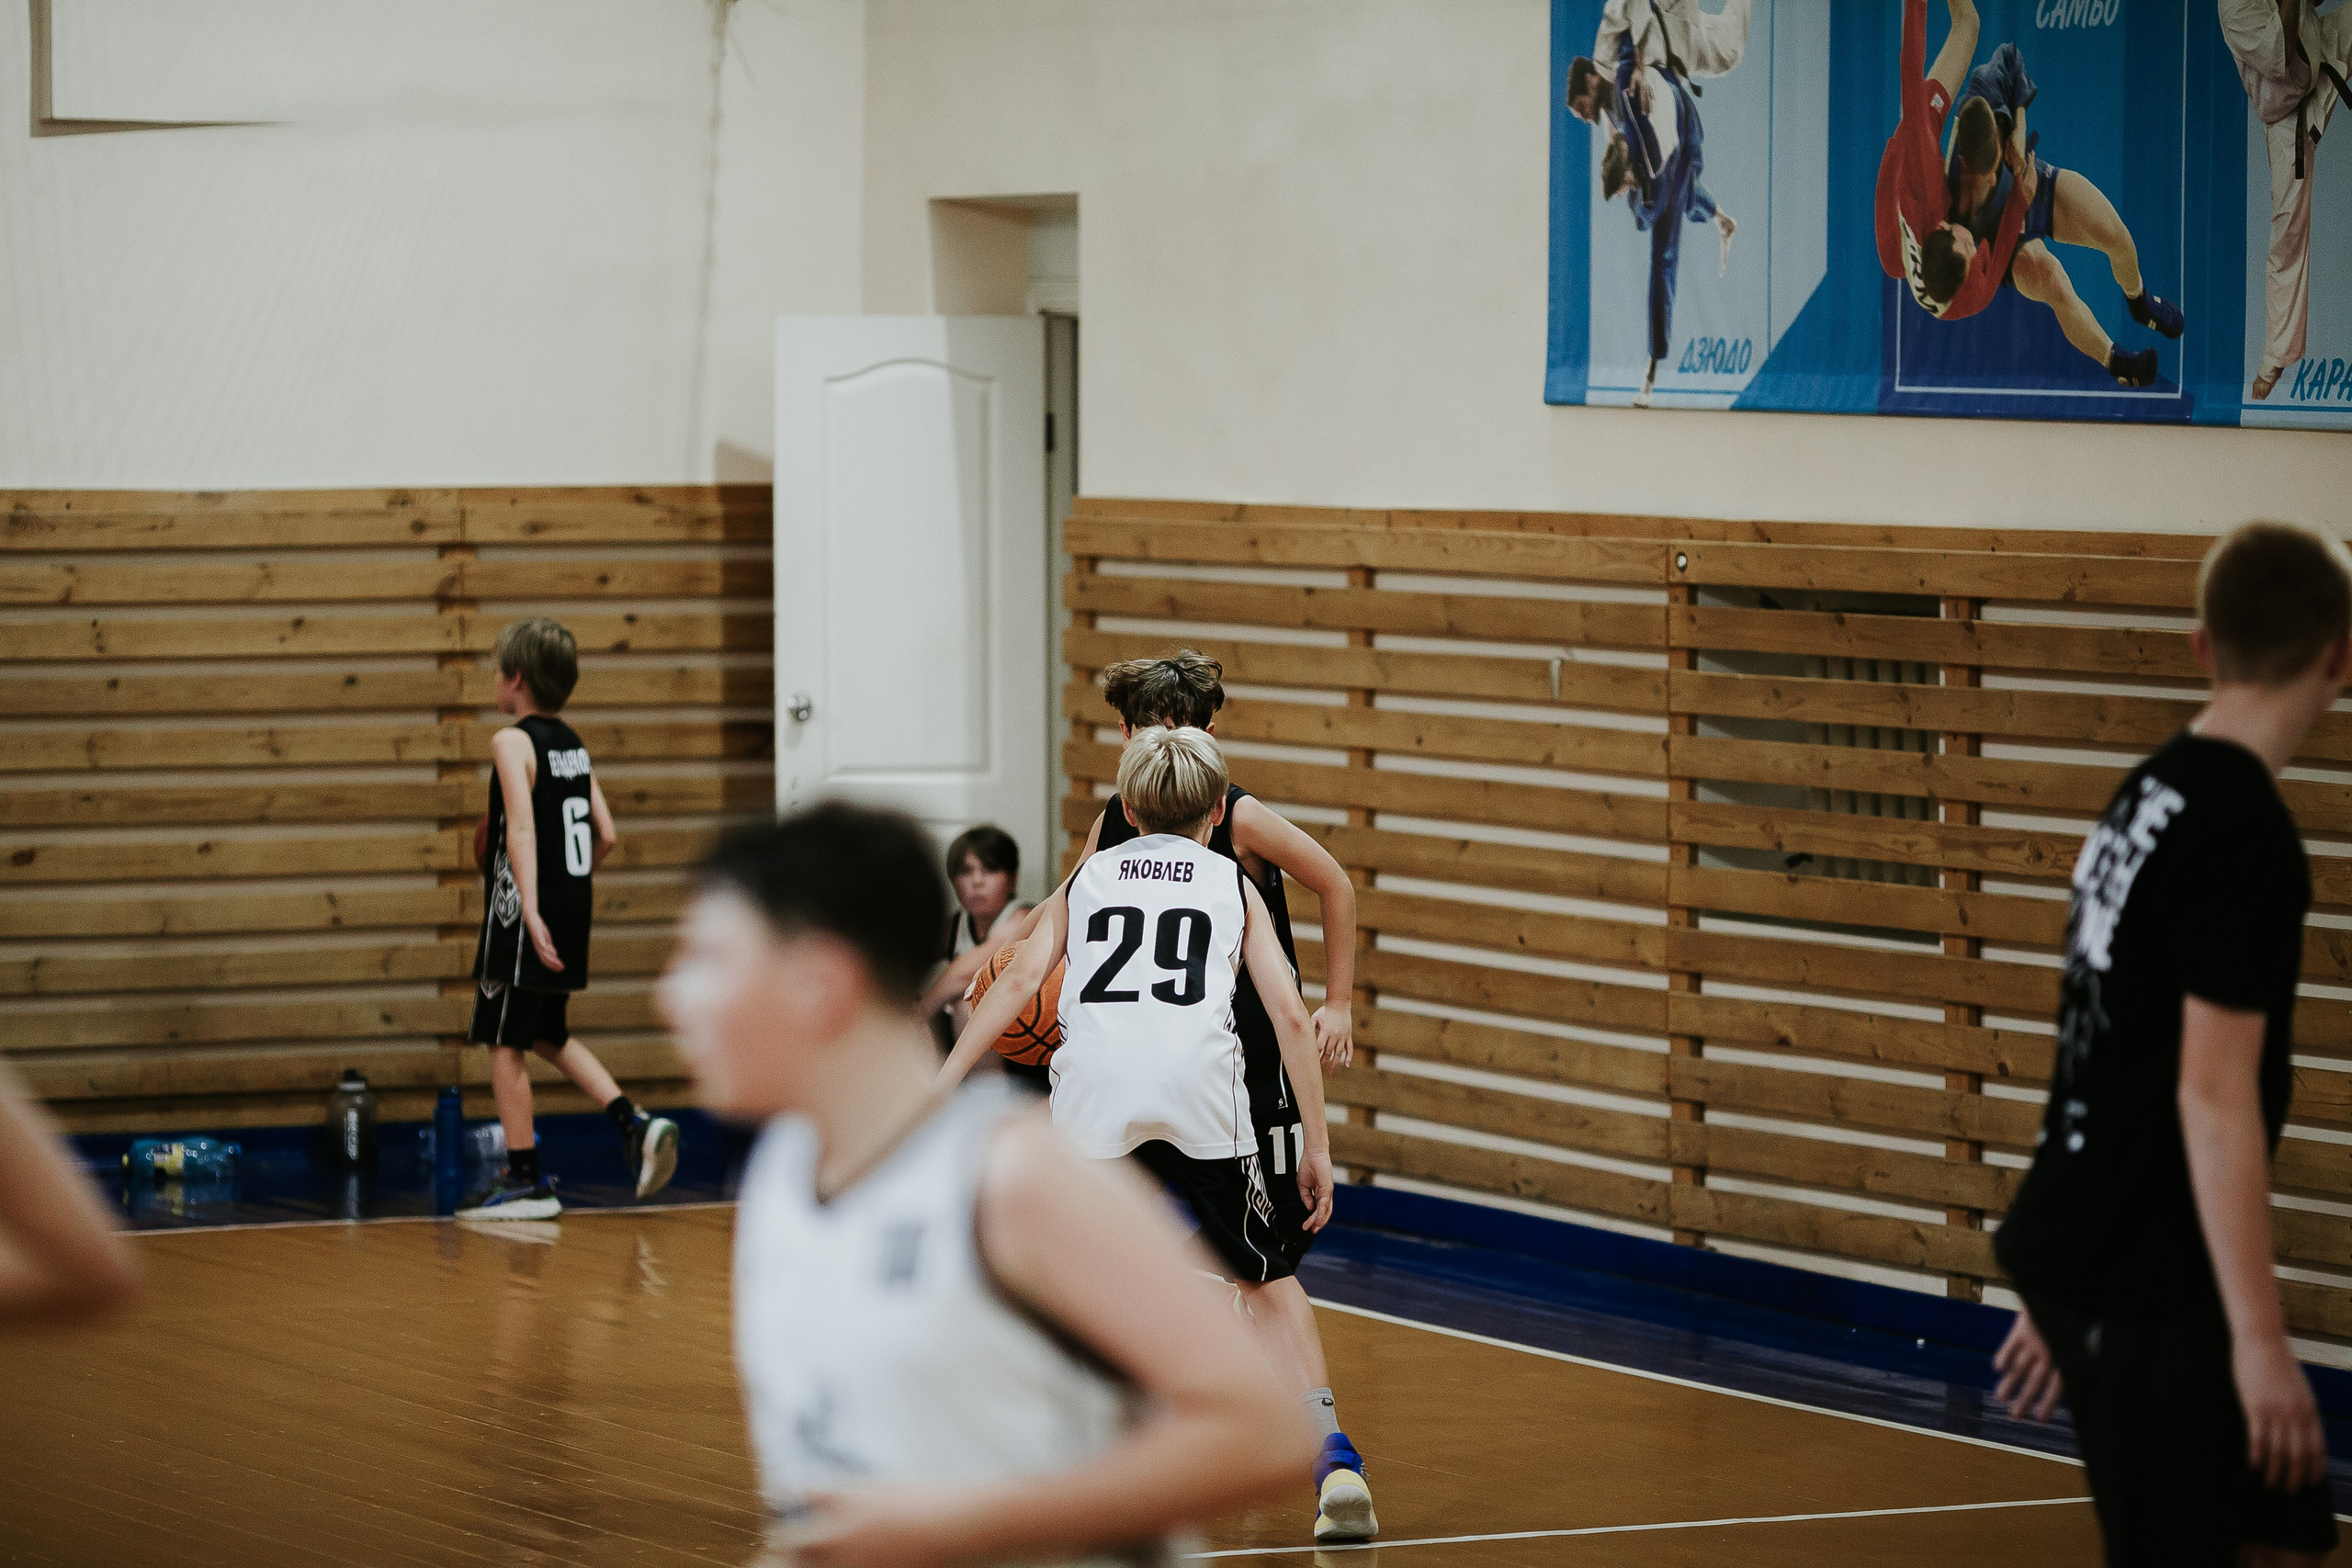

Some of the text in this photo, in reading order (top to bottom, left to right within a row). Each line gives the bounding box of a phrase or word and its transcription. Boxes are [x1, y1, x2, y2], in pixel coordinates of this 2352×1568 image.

[1677, 336, 1753, 374] ДЗЮДО
[561, 795, 593, 876] 6
[1117, 858, 1194, 883] ЯКОВЛЕВ
[1080, 906, 1212, 1006] 29
[1268, 1122, 1305, 1175] 11
